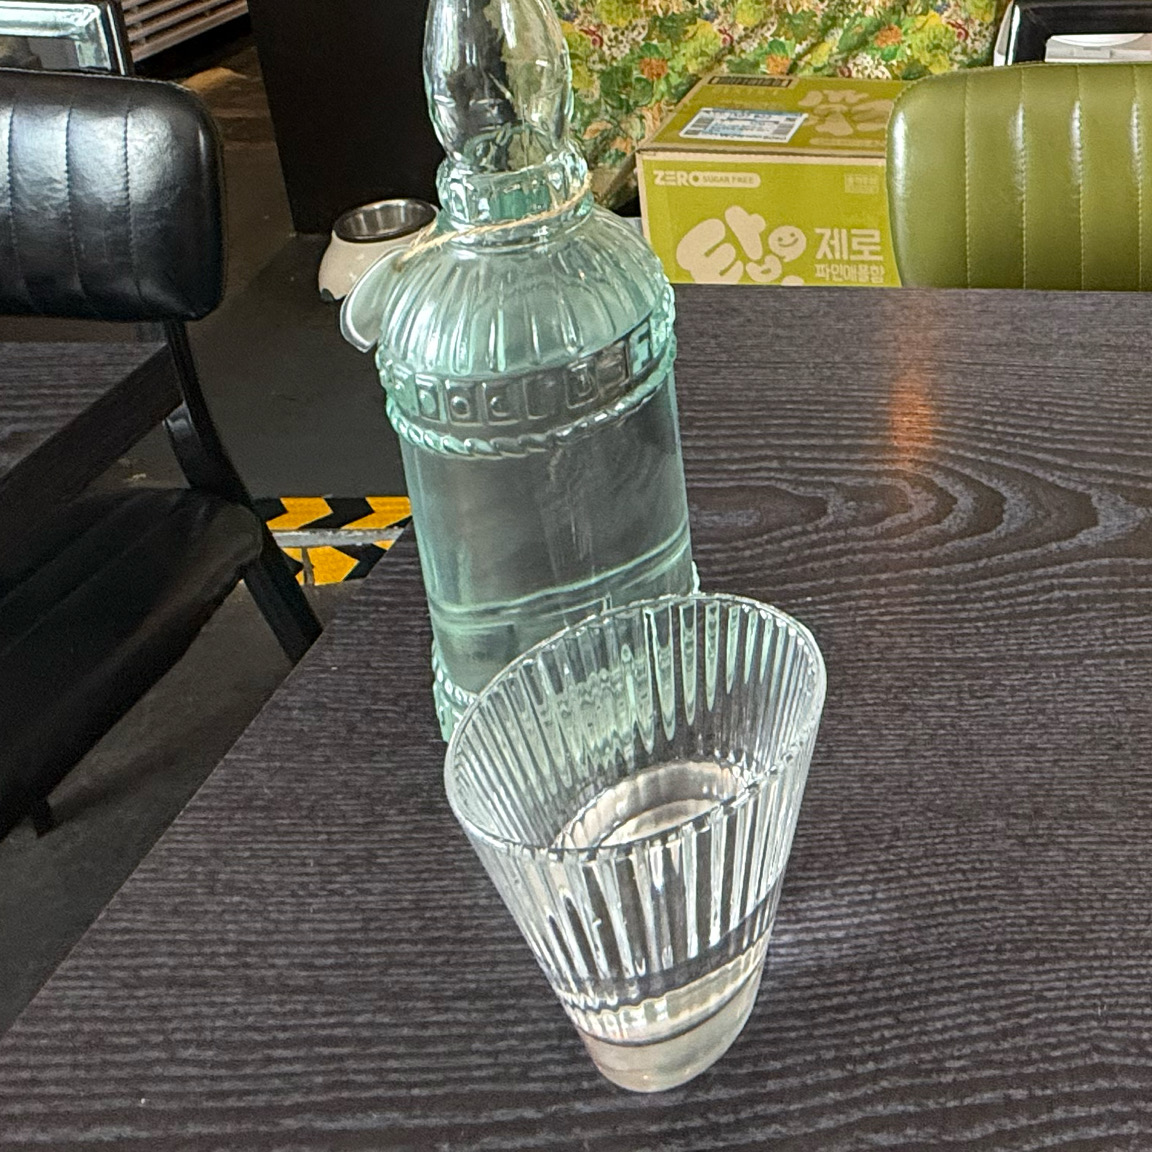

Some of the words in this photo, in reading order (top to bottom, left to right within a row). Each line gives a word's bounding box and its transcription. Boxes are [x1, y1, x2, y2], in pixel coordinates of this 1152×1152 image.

[653, 170, 702, 187] ZERO
[701, 174, 730, 185] SUGAR
[732, 175, 756, 185] FREE
[814, 228, 884, 262] 제로
[814, 264, 885, 283] 파인애플향
